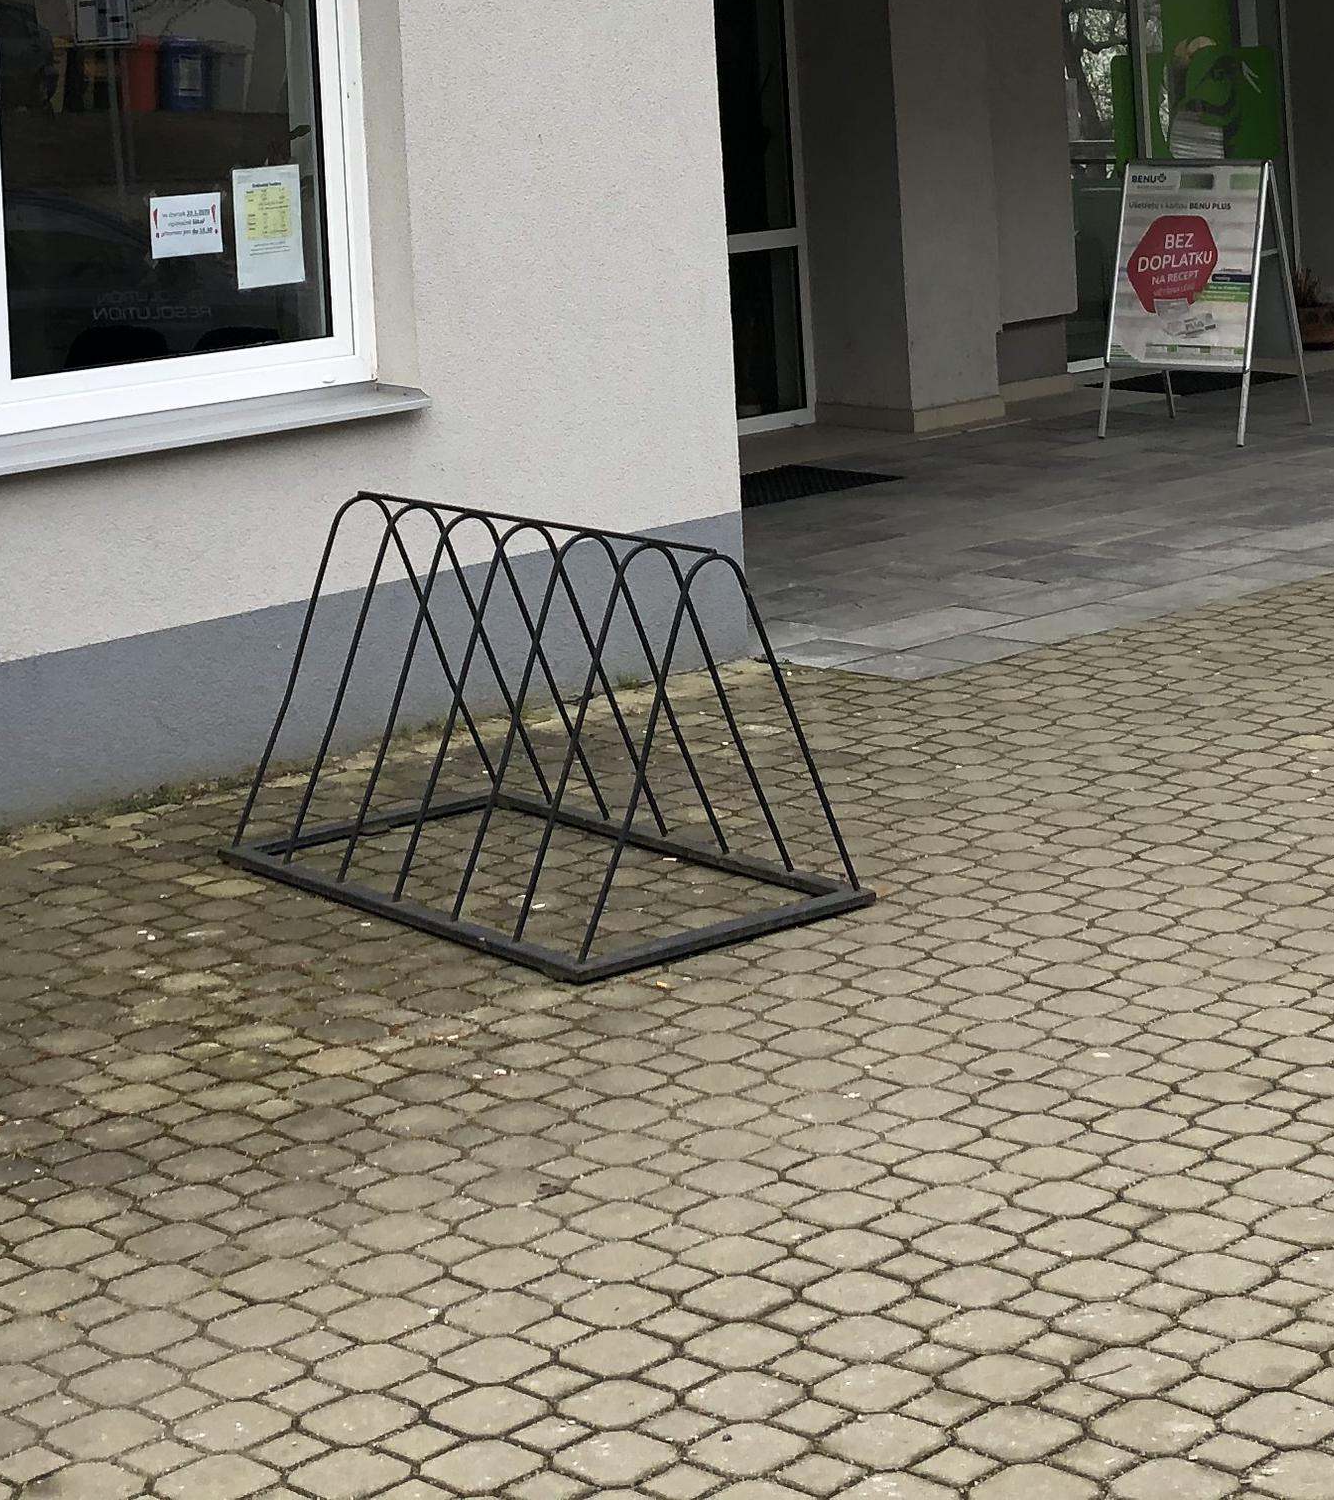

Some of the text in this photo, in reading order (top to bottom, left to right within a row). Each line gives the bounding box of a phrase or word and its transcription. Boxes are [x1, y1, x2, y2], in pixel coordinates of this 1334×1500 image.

[1131, 174, 1157, 184] BENU
[1189, 202, 1210, 210] BENU
[1164, 232, 1195, 249] BEZ
[1137, 250, 1213, 273] DOPLATKU
[1151, 269, 1199, 285] NA RECEPT
